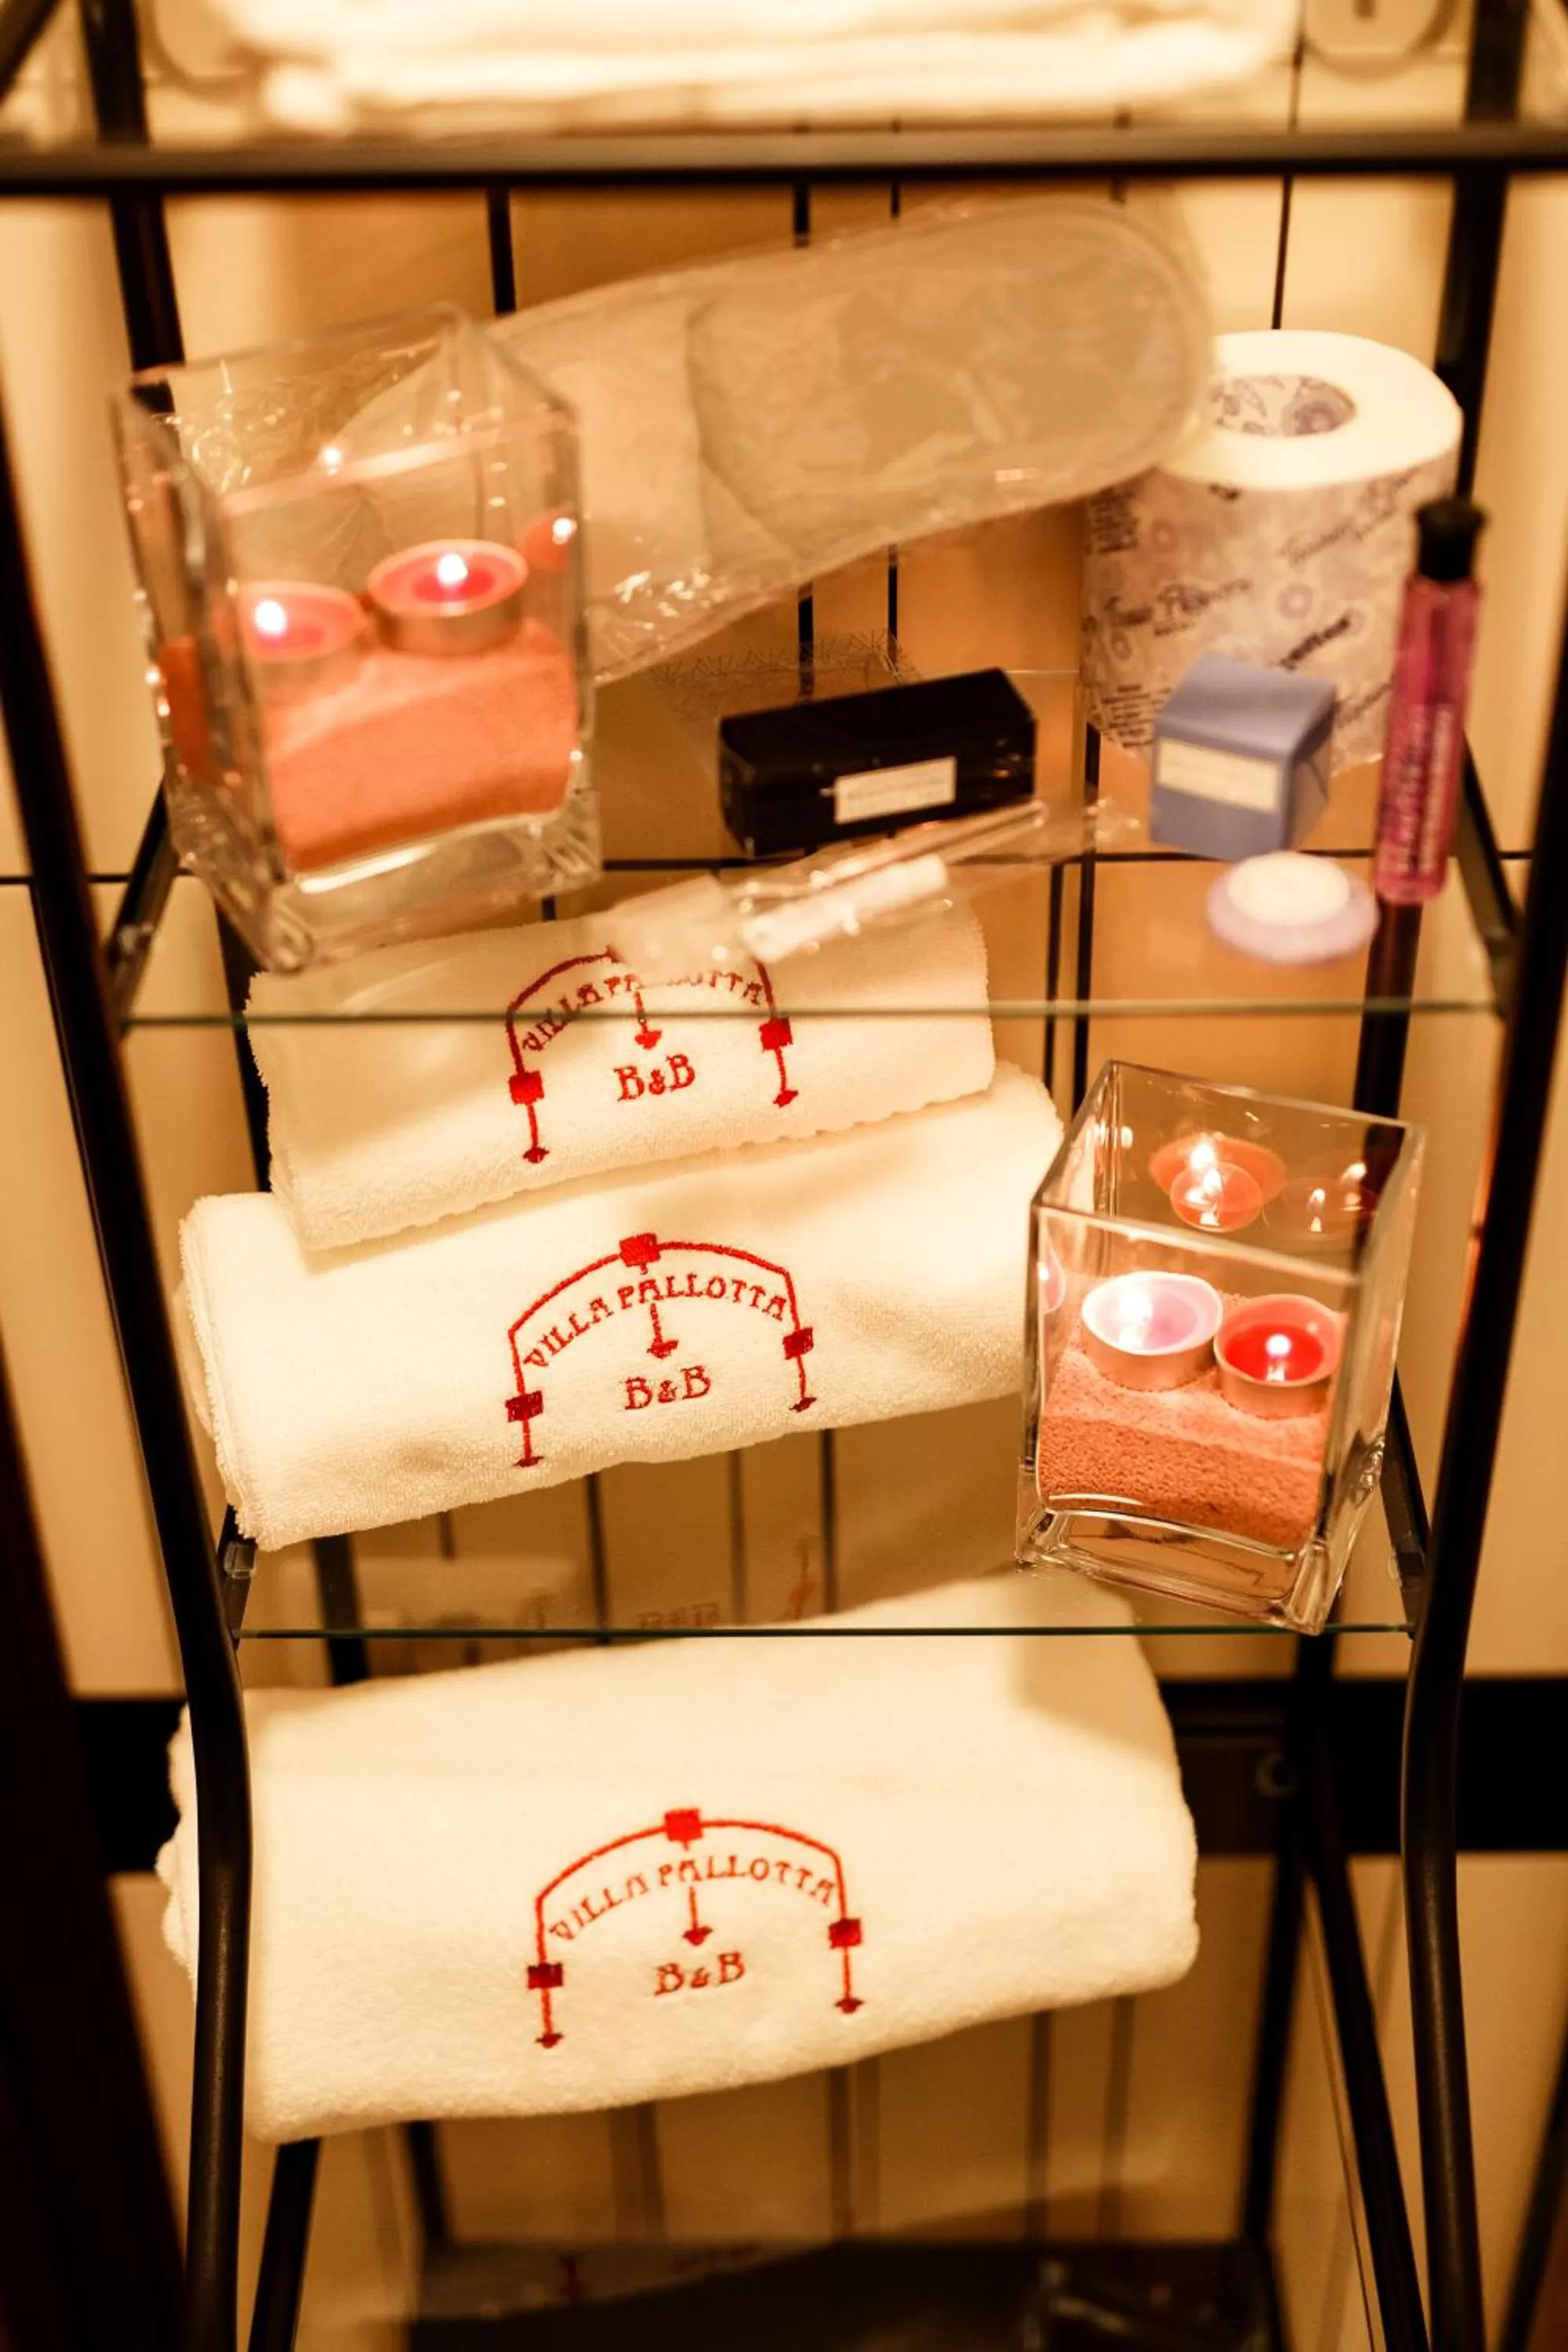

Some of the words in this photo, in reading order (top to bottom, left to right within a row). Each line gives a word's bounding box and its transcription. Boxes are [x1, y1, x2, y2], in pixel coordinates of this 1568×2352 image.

[522, 982, 604, 1051] VILLA
[613, 1053, 695, 1102] B&B
[523, 1296, 615, 1368] VILLA
[616, 1272, 787, 1321] PALLOTTA
[623, 1365, 711, 1410] B&B
[549, 1871, 650, 1941] VILLA
[657, 1855, 837, 1907] PALLOTTA
[654, 1951, 746, 1997] B&B
